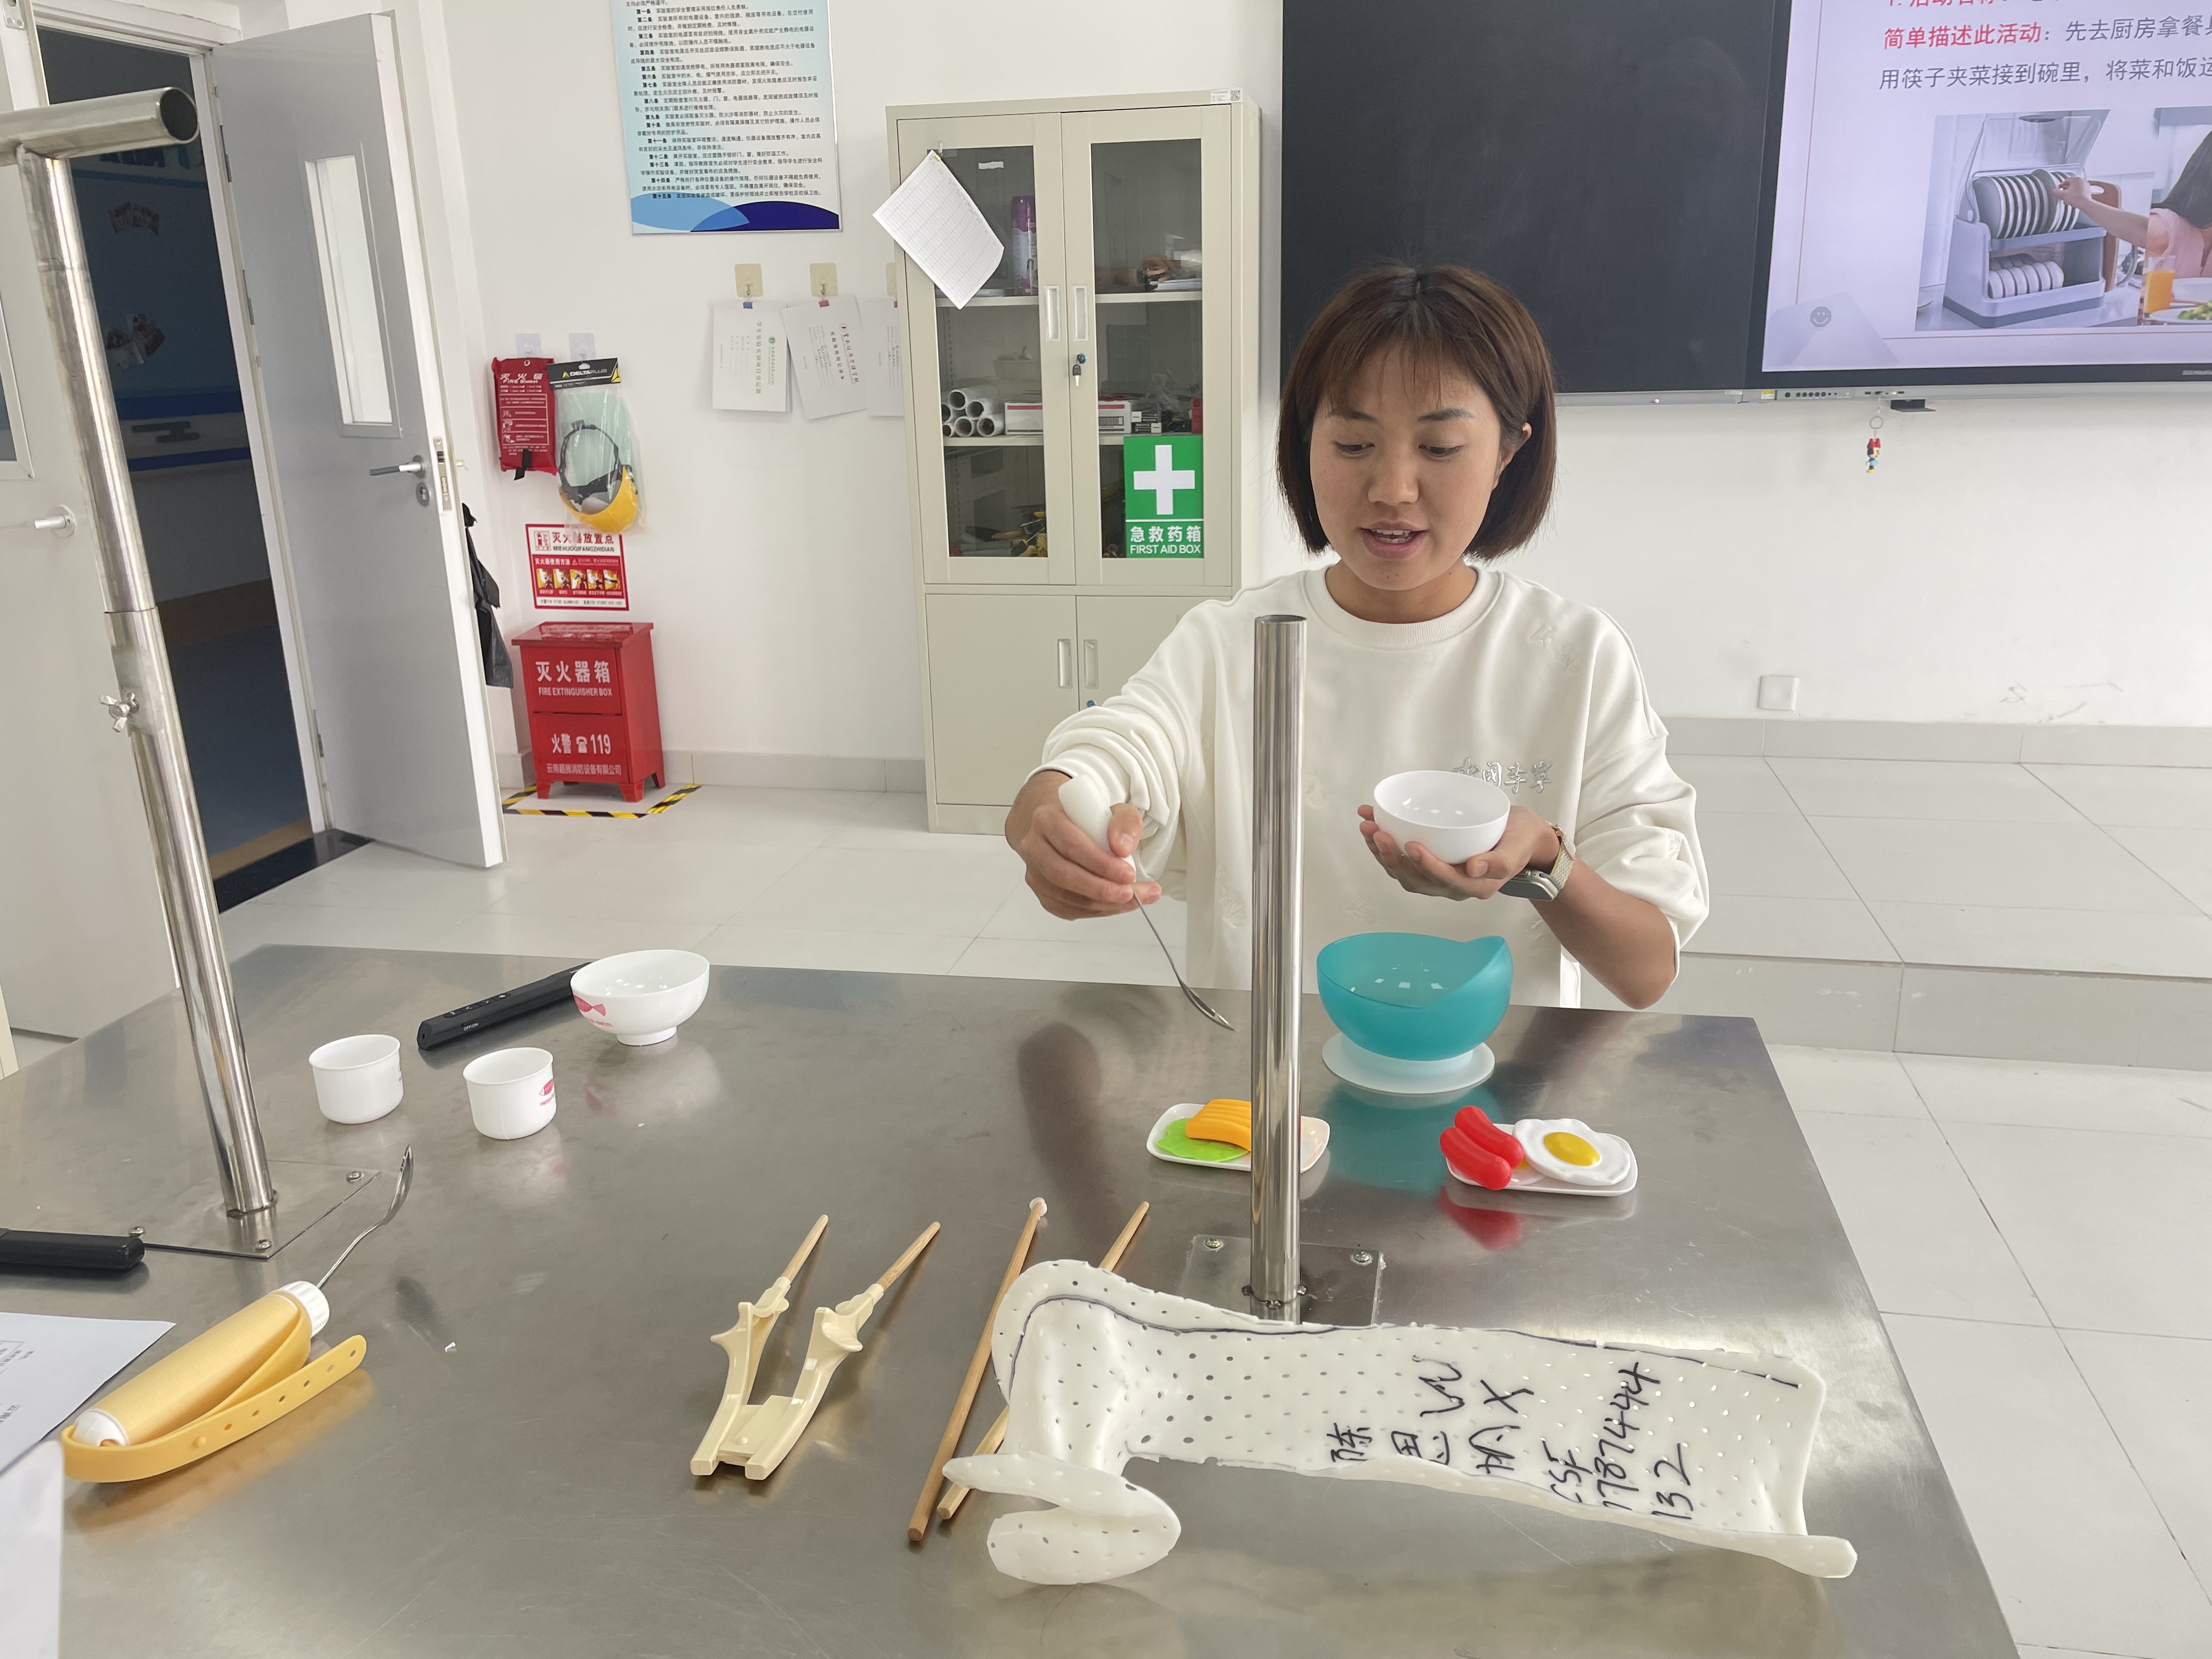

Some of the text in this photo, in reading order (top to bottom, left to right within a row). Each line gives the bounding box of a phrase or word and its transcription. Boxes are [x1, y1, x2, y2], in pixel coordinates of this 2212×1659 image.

[1130, 526, 1201, 543] 急救药箱
[1130, 544, 1201, 554] FIRST AID BOX
[535, 660, 611, 684] 灭火器箱
[539, 687, 612, 697] FIRE EXTINGUISHER BOX
[551, 733, 611, 755] 火警 119
[1652, 1443, 1694, 1520] 132
